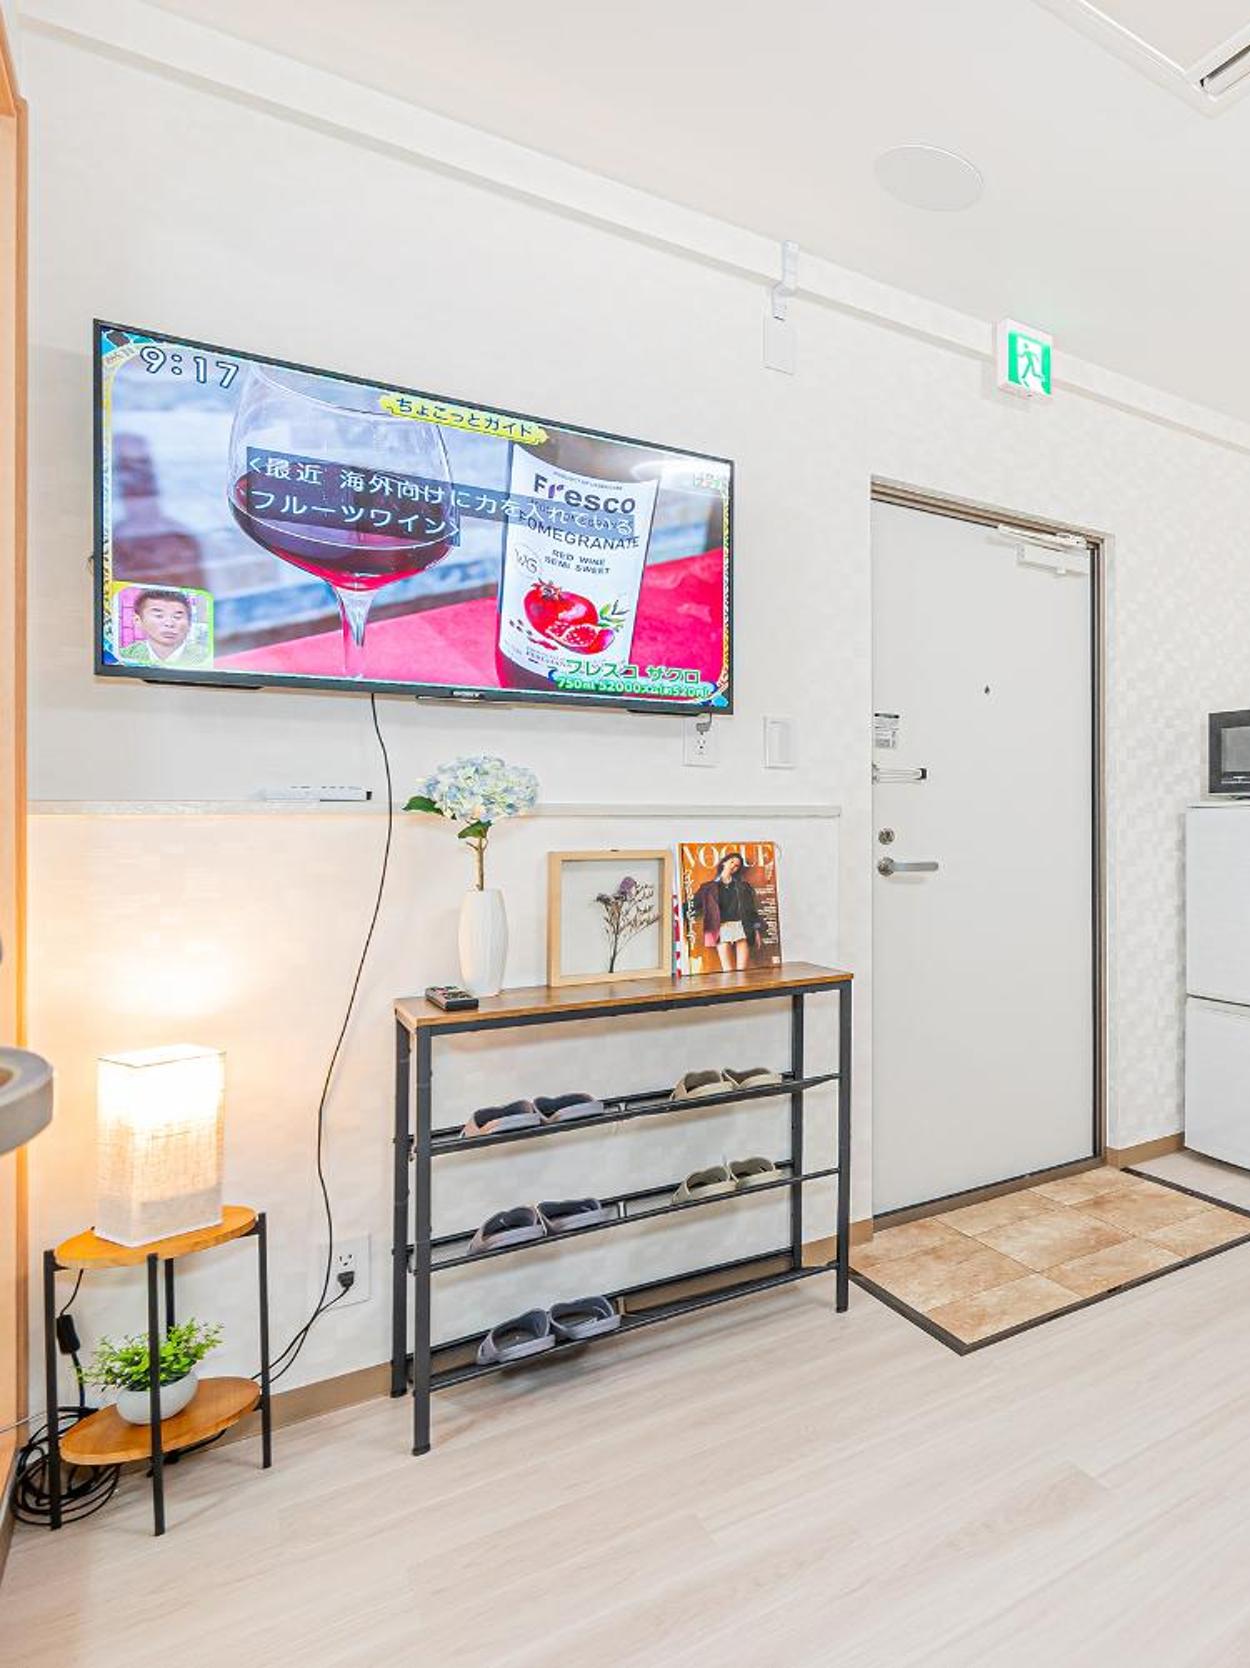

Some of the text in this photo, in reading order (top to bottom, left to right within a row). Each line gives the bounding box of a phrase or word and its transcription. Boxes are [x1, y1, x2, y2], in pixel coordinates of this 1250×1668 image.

[140, 346, 239, 389] 9:17
[534, 473, 636, 514] Fresco
[566, 659, 637, 680] フレスコ
[647, 666, 699, 684] ザクロ
[682, 844, 774, 868] VOGUE
